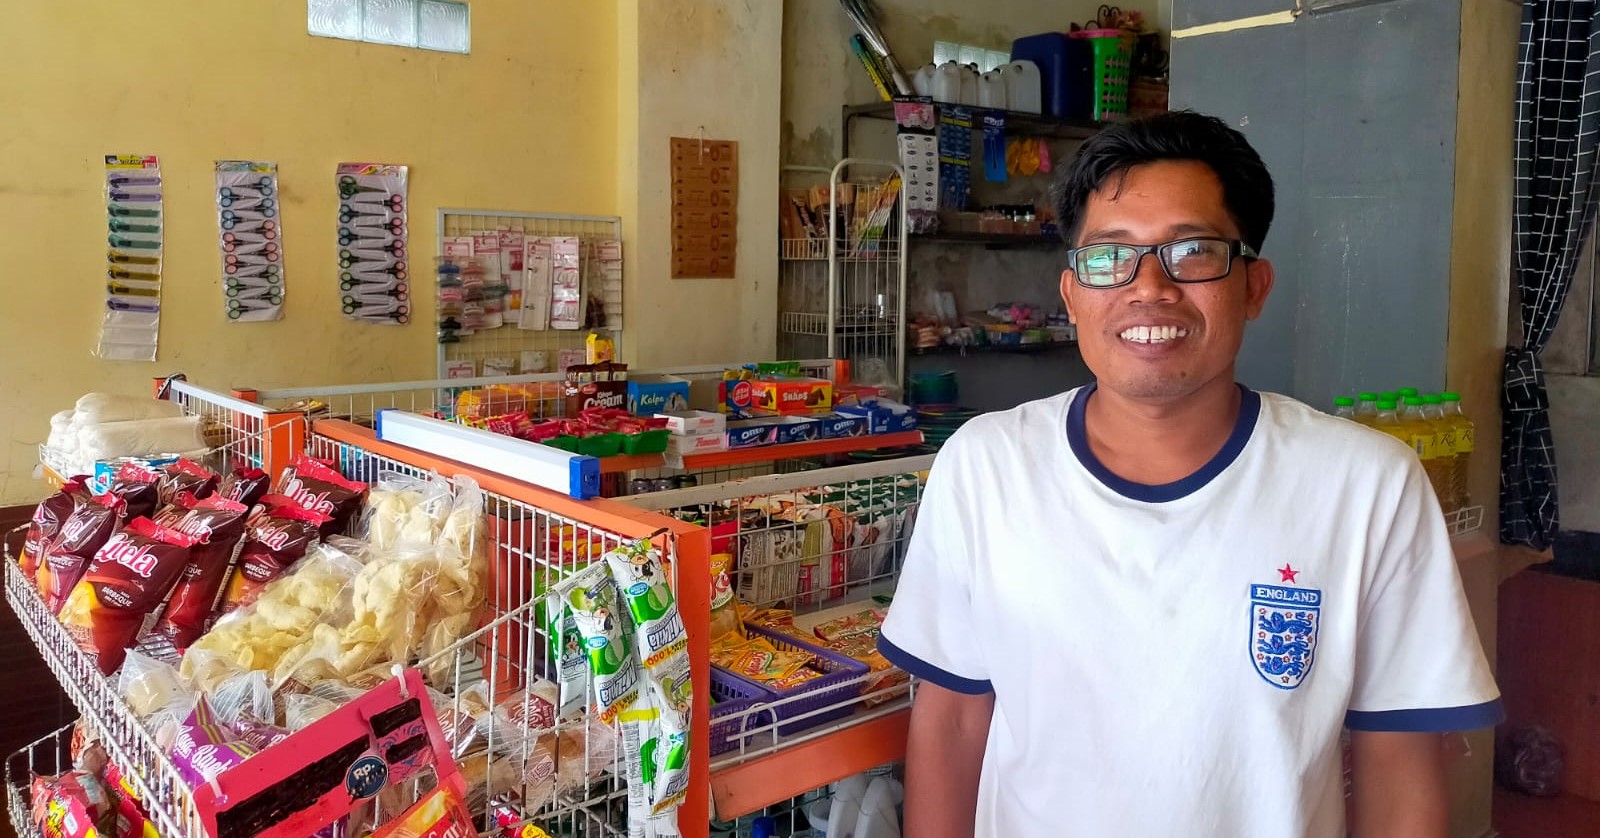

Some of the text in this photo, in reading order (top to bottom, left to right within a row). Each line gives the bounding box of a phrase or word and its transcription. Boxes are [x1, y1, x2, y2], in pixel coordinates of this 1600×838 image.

[583, 394, 623, 411] Cream
[640, 393, 664, 405] Kalpa
[741, 427, 765, 440] OREO
[1255, 587, 1318, 603] ENGLAND
[353, 763, 375, 780] Rp.
